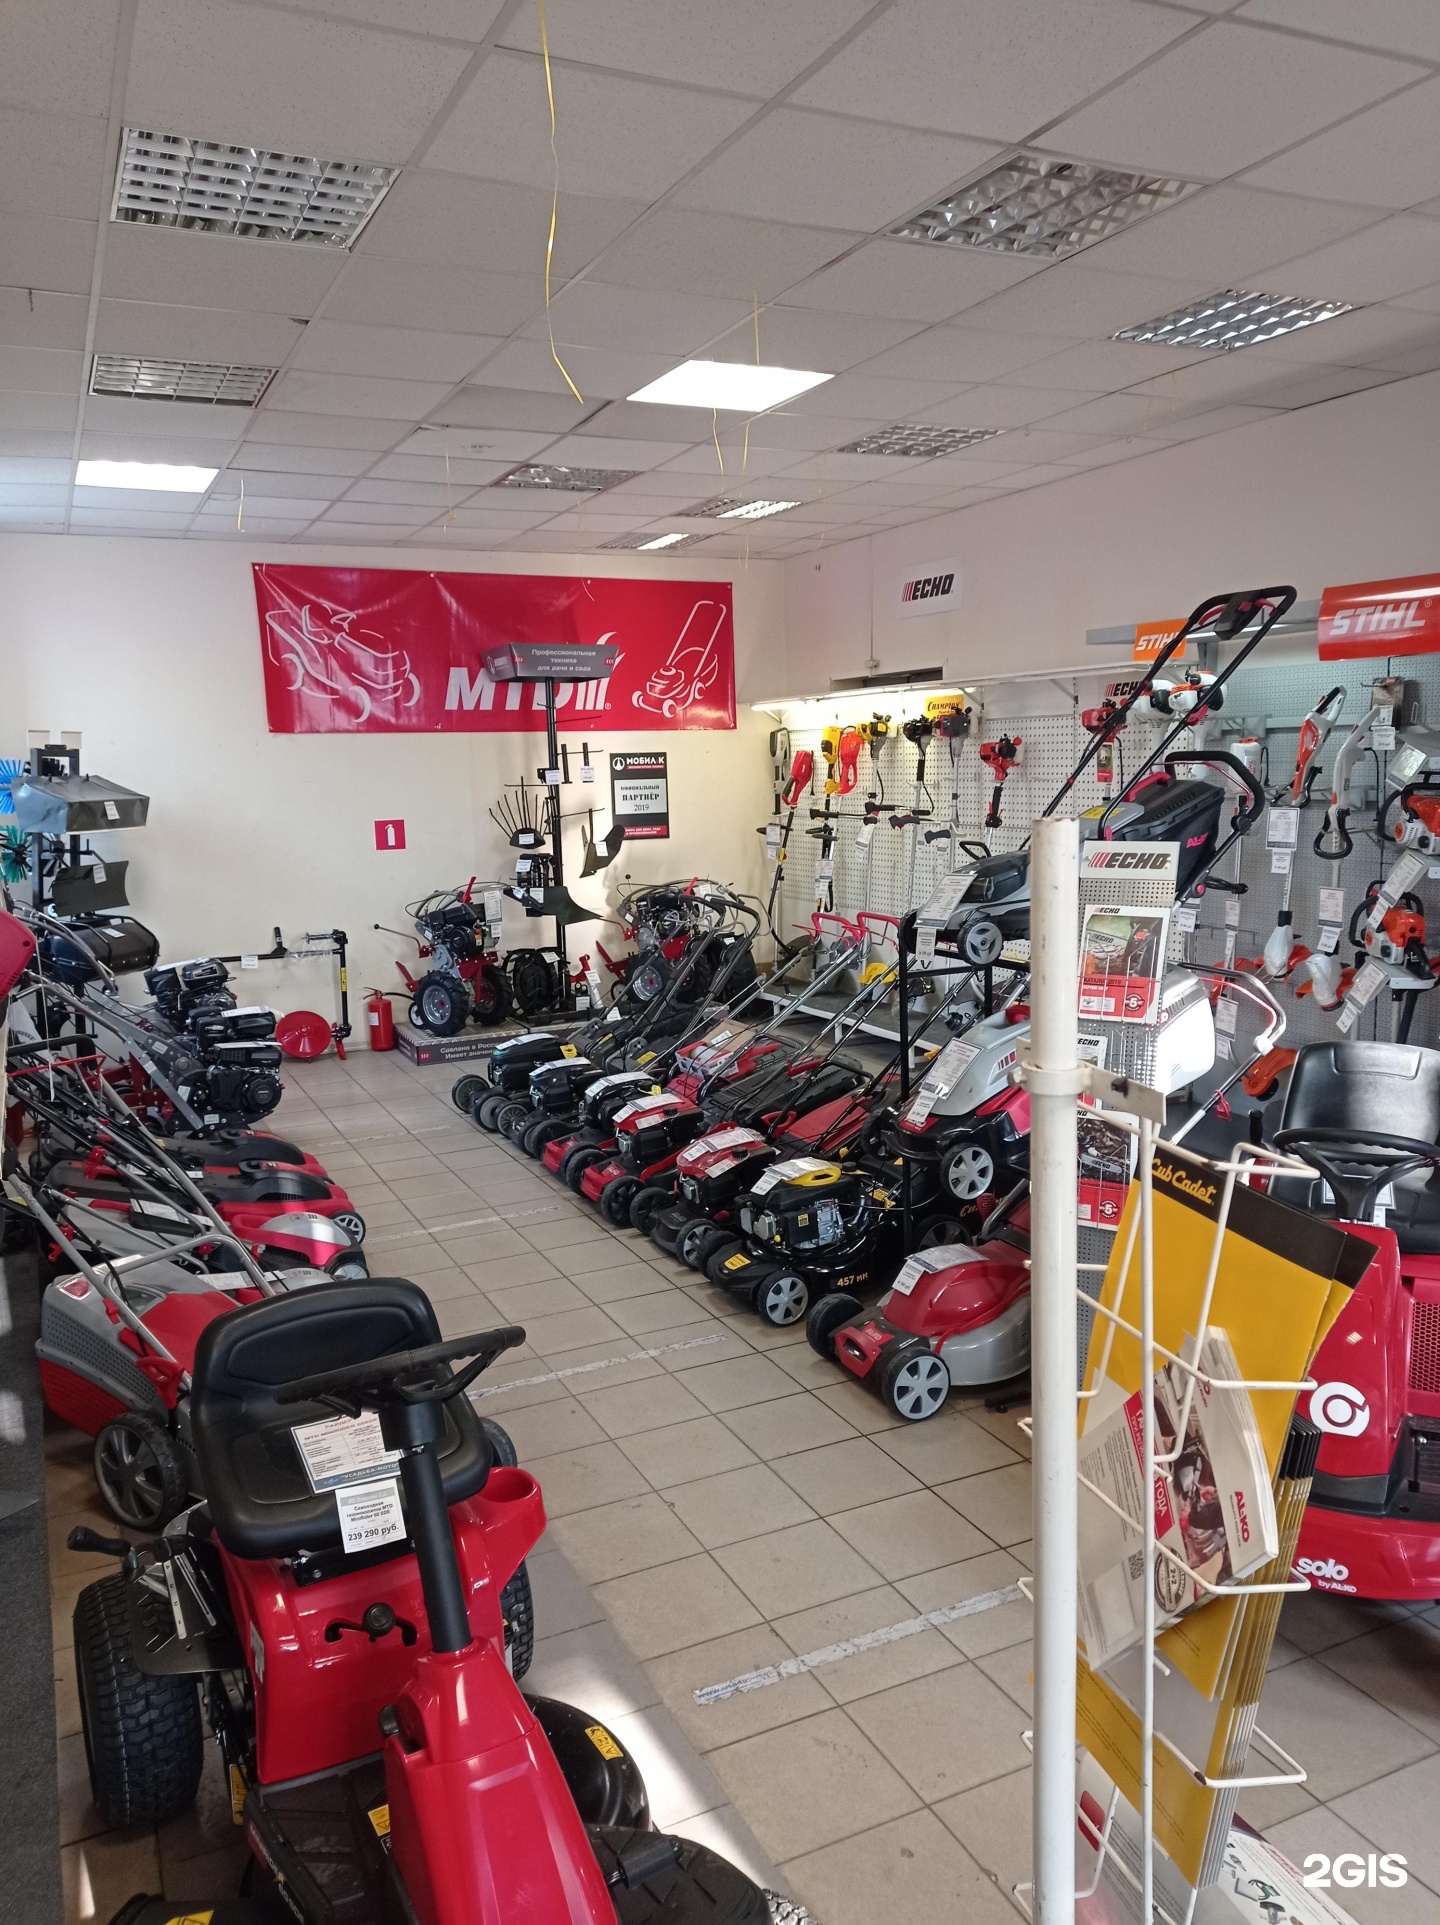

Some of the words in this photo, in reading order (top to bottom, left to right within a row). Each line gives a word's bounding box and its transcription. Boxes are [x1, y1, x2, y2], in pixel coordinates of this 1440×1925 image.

[909, 573, 955, 601] ECHO
[1329, 601, 1427, 636] STIHL
[1135, 631, 1182, 652] STIH
[531, 648, 597, 658] Профессиональная
[1111, 681, 1144, 697] ECH
[626, 757, 656, 765] МОБИЛ
[622, 792, 660, 801] ПАРТНЁР
[633, 803, 650, 812] 2019
[1101, 852, 1171, 870] ECHO
[1095, 934, 1114, 944] ECHO
[1077, 1038, 1100, 1047] ECHO
[440, 1046, 470, 1054] Сделано
[445, 1052, 467, 1060] Имеет
[1094, 1160, 1111, 1170] ECHO
[1152, 1158, 1173, 1183] Cub
[1171, 1170, 1217, 1205] Cadet
[836, 1275, 855, 1287] 457
[1234, 1490, 1251, 1544] AL-KO
[347, 1532, 363, 1542] 239
[364, 1528, 380, 1539] 290
[381, 1523, 400, 1537] руб.
[1296, 1557, 1349, 1581] solo
[1318, 1579, 1331, 1590] by
[1330, 1582, 1357, 1593] AL-KO
